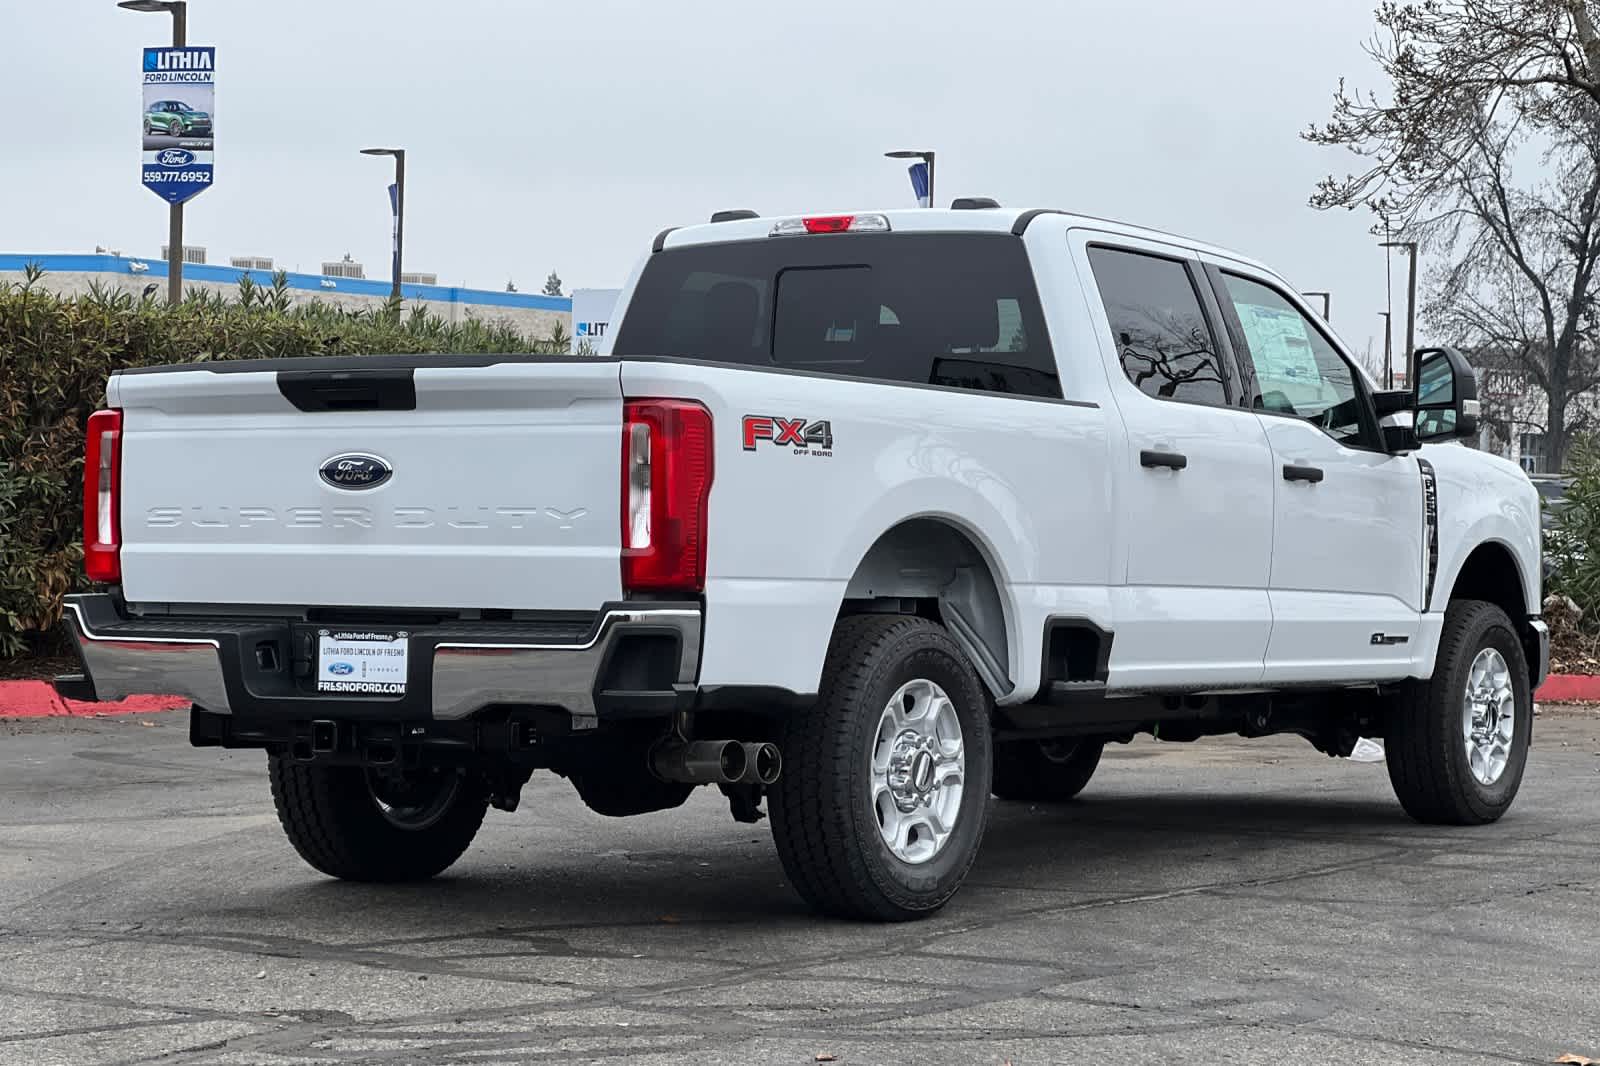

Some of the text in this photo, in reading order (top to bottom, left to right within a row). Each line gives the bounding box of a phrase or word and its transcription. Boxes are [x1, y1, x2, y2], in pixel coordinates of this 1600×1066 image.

[157, 51, 212, 69] LITHIA
[144, 72, 211, 82] FORD LINCOLN
[162, 151, 188, 164] Ford
[144, 171, 210, 182] 559.777.6952
[588, 322, 609, 336] LIT
[742, 414, 833, 451] FX4
[335, 460, 375, 480] Ford
[147, 506, 587, 529] SUPER DUTY
[323, 648, 339, 656] LITHIA
[340, 648, 353, 656] FORD
[354, 648, 375, 656] LINCOLN
[384, 648, 404, 657] FRESNO
[318, 682, 406, 693] FRESNOFORD.COM
